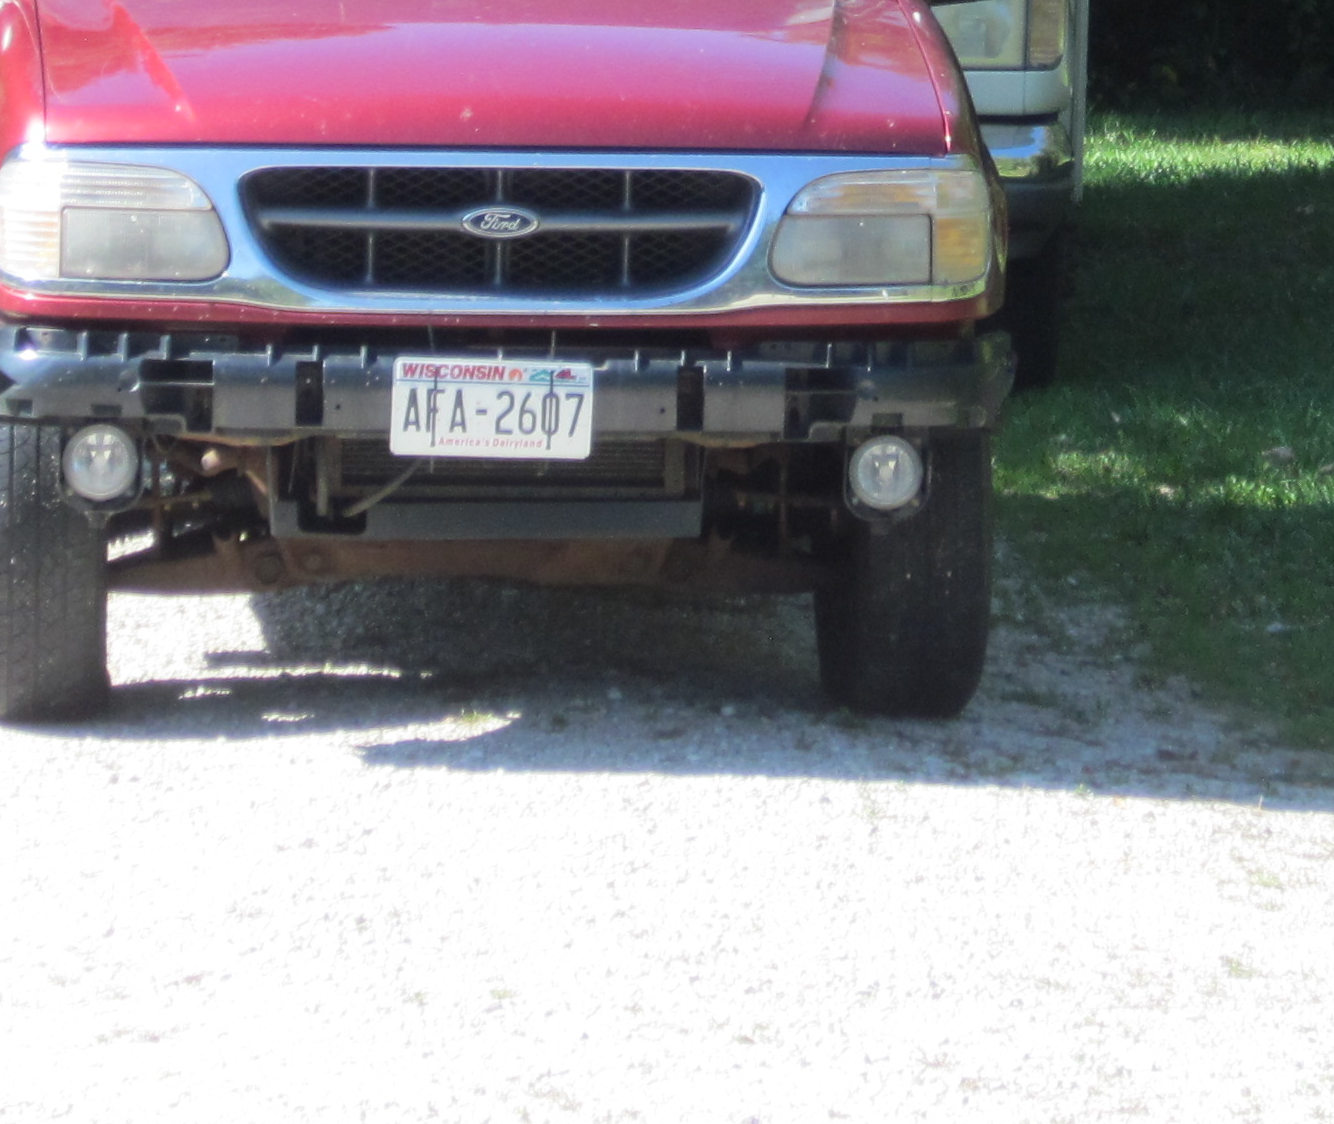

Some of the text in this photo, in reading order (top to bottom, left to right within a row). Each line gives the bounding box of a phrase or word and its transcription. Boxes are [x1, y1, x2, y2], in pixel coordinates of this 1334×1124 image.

[480, 212, 521, 231] Ford
[402, 362, 507, 382] WISCONSIN
[402, 387, 585, 438] AFA-2607
[437, 437, 544, 450] America's Dairyland
